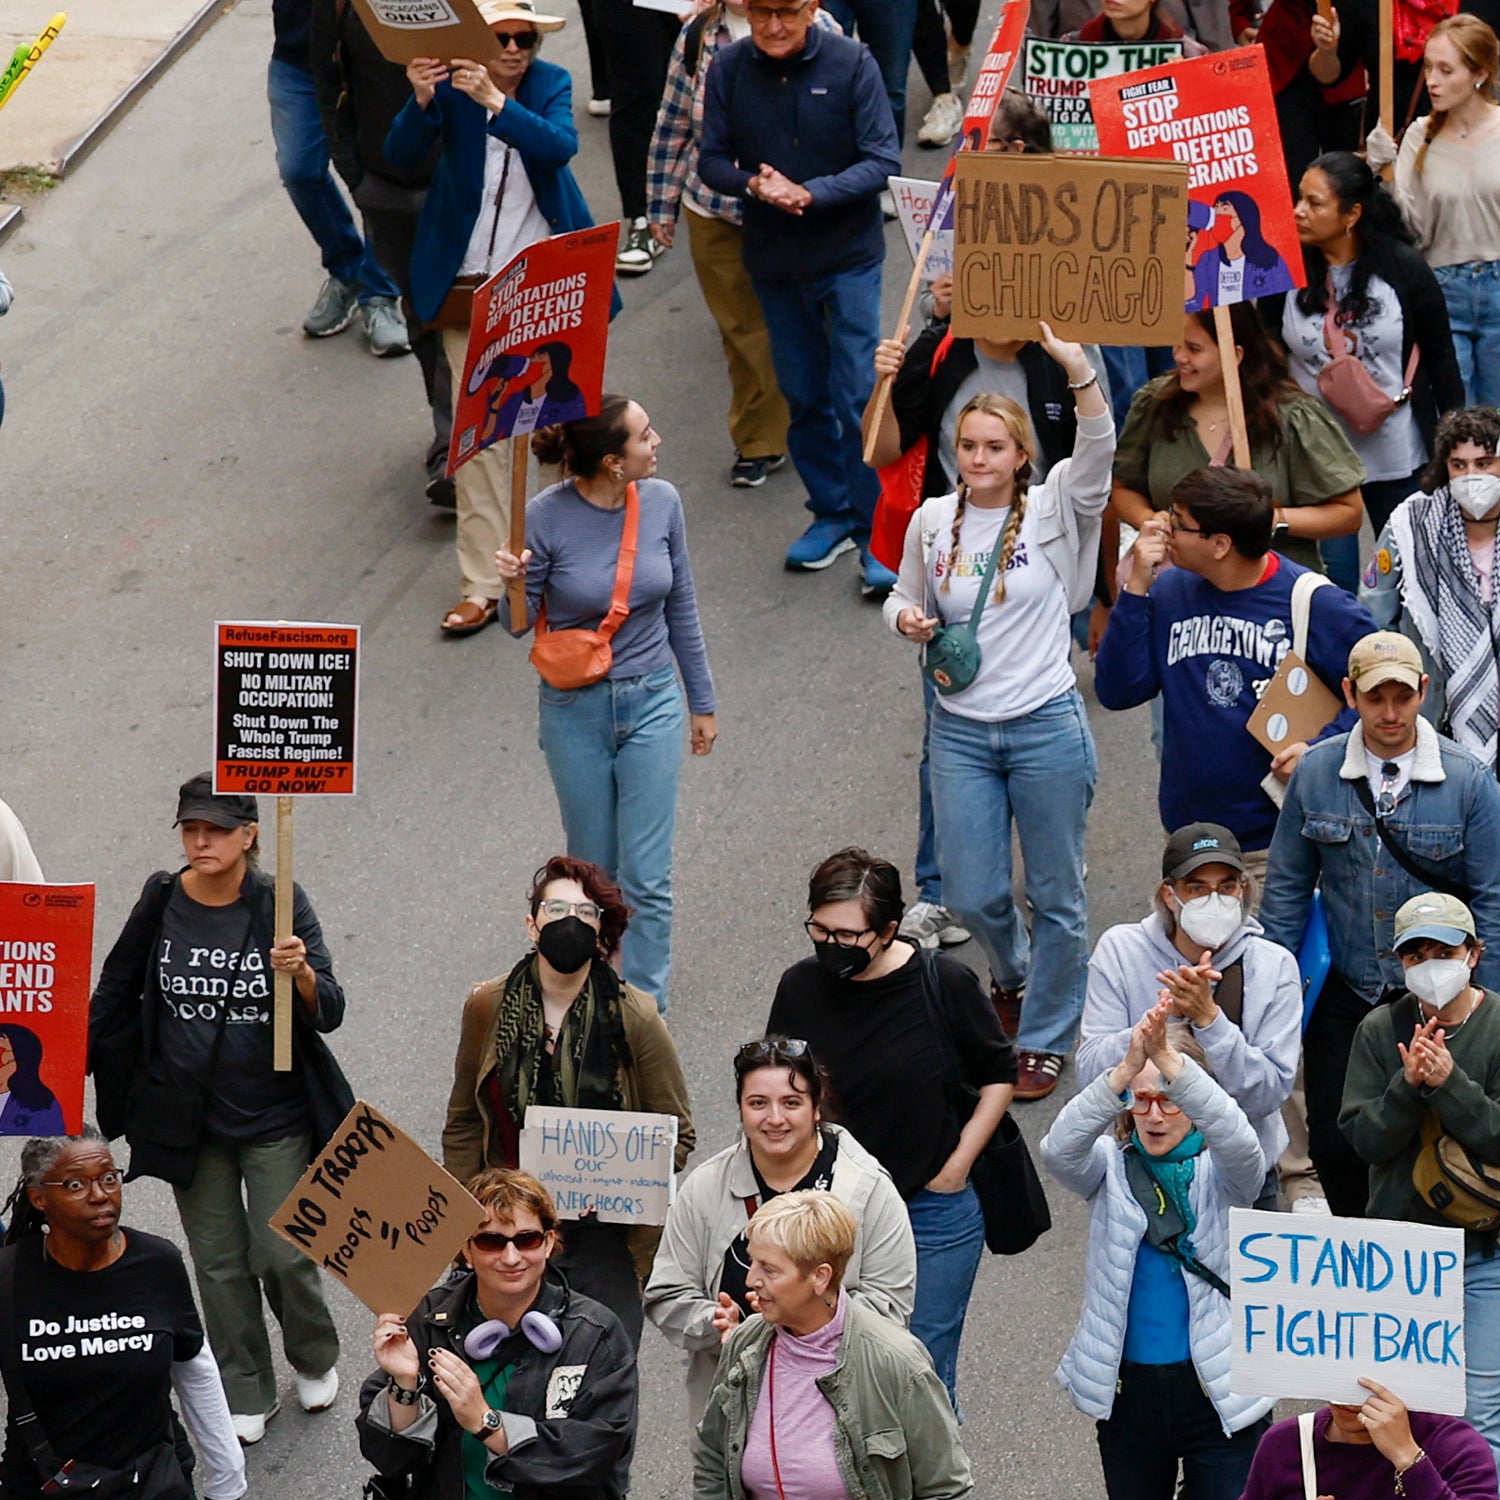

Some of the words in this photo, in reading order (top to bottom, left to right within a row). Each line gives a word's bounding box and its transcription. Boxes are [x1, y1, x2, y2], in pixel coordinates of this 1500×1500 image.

[956, 177, 1081, 252] HANDS
[1093, 177, 1180, 255] OFF
[962, 252, 1163, 326] CHICAGO
[226, 629, 348, 645] RefuseFascism.org
[224, 651, 263, 668] SHUT
[269, 653, 314, 669] DOWN
[319, 654, 350, 670] ICE!
[241, 674, 261, 689] NO
[265, 675, 332, 690] MILITARY
[239, 691, 333, 708] OCCUPATION!
[233, 714, 265, 728] Shut
[270, 715, 308, 729] Down
[312, 716, 338, 729] The
[240, 730, 284, 744] Whole
[289, 731, 331, 747] Trump
[228, 745, 280, 759] Fascist
[284, 746, 342, 762] Regime!
[225, 765, 290, 777] TRUMP
[295, 766, 348, 778] MUST
[245, 780, 272, 792] GO
[277, 781, 326, 792] NOW!
[1239, 1232, 1394, 1295] STAND
[1403, 1249, 1458, 1298] UP
[28, 1318, 59, 1338] Do
[65, 1314, 145, 1334] Justice
[1245, 1304, 1373, 1360] FIGHT
[1375, 1315, 1461, 1366] BACK
[21, 1341, 75, 1363] Love
[83, 1332, 153, 1359] Mercy
